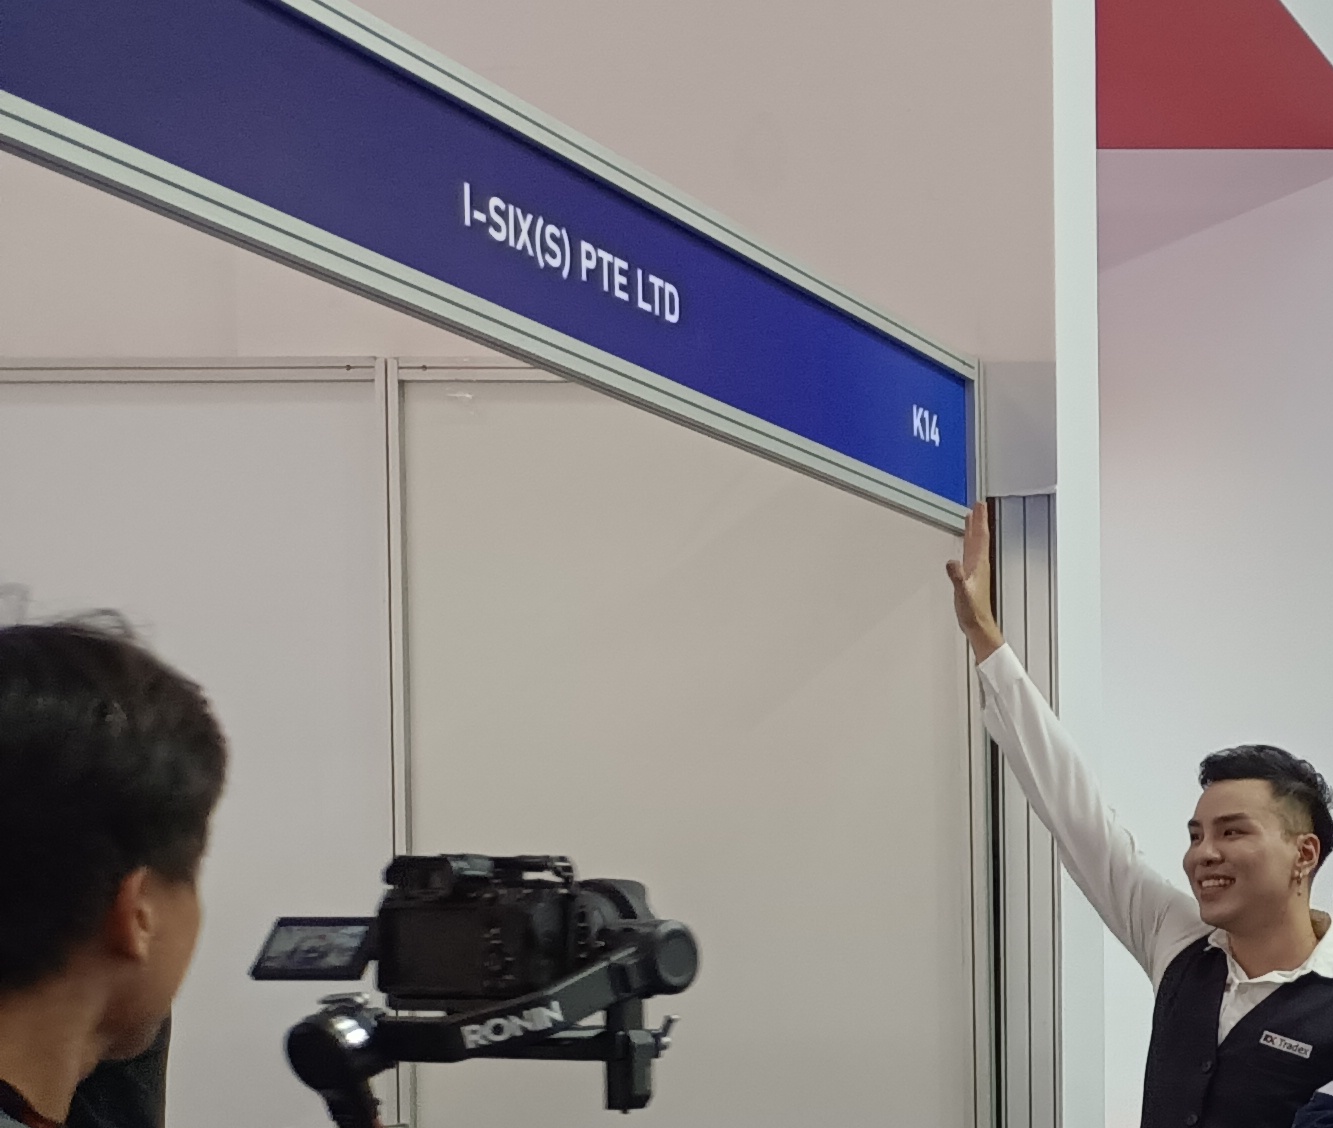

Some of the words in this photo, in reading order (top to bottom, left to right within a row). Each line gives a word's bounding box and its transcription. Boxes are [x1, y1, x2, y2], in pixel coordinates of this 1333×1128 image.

[464, 181, 571, 280] I-SIX(S)
[580, 240, 629, 301] PTE
[637, 268, 680, 324] LTD
[911, 403, 941, 447] K14
[460, 1000, 564, 1050] RONIN
[1279, 1037, 1310, 1056] Tradex
